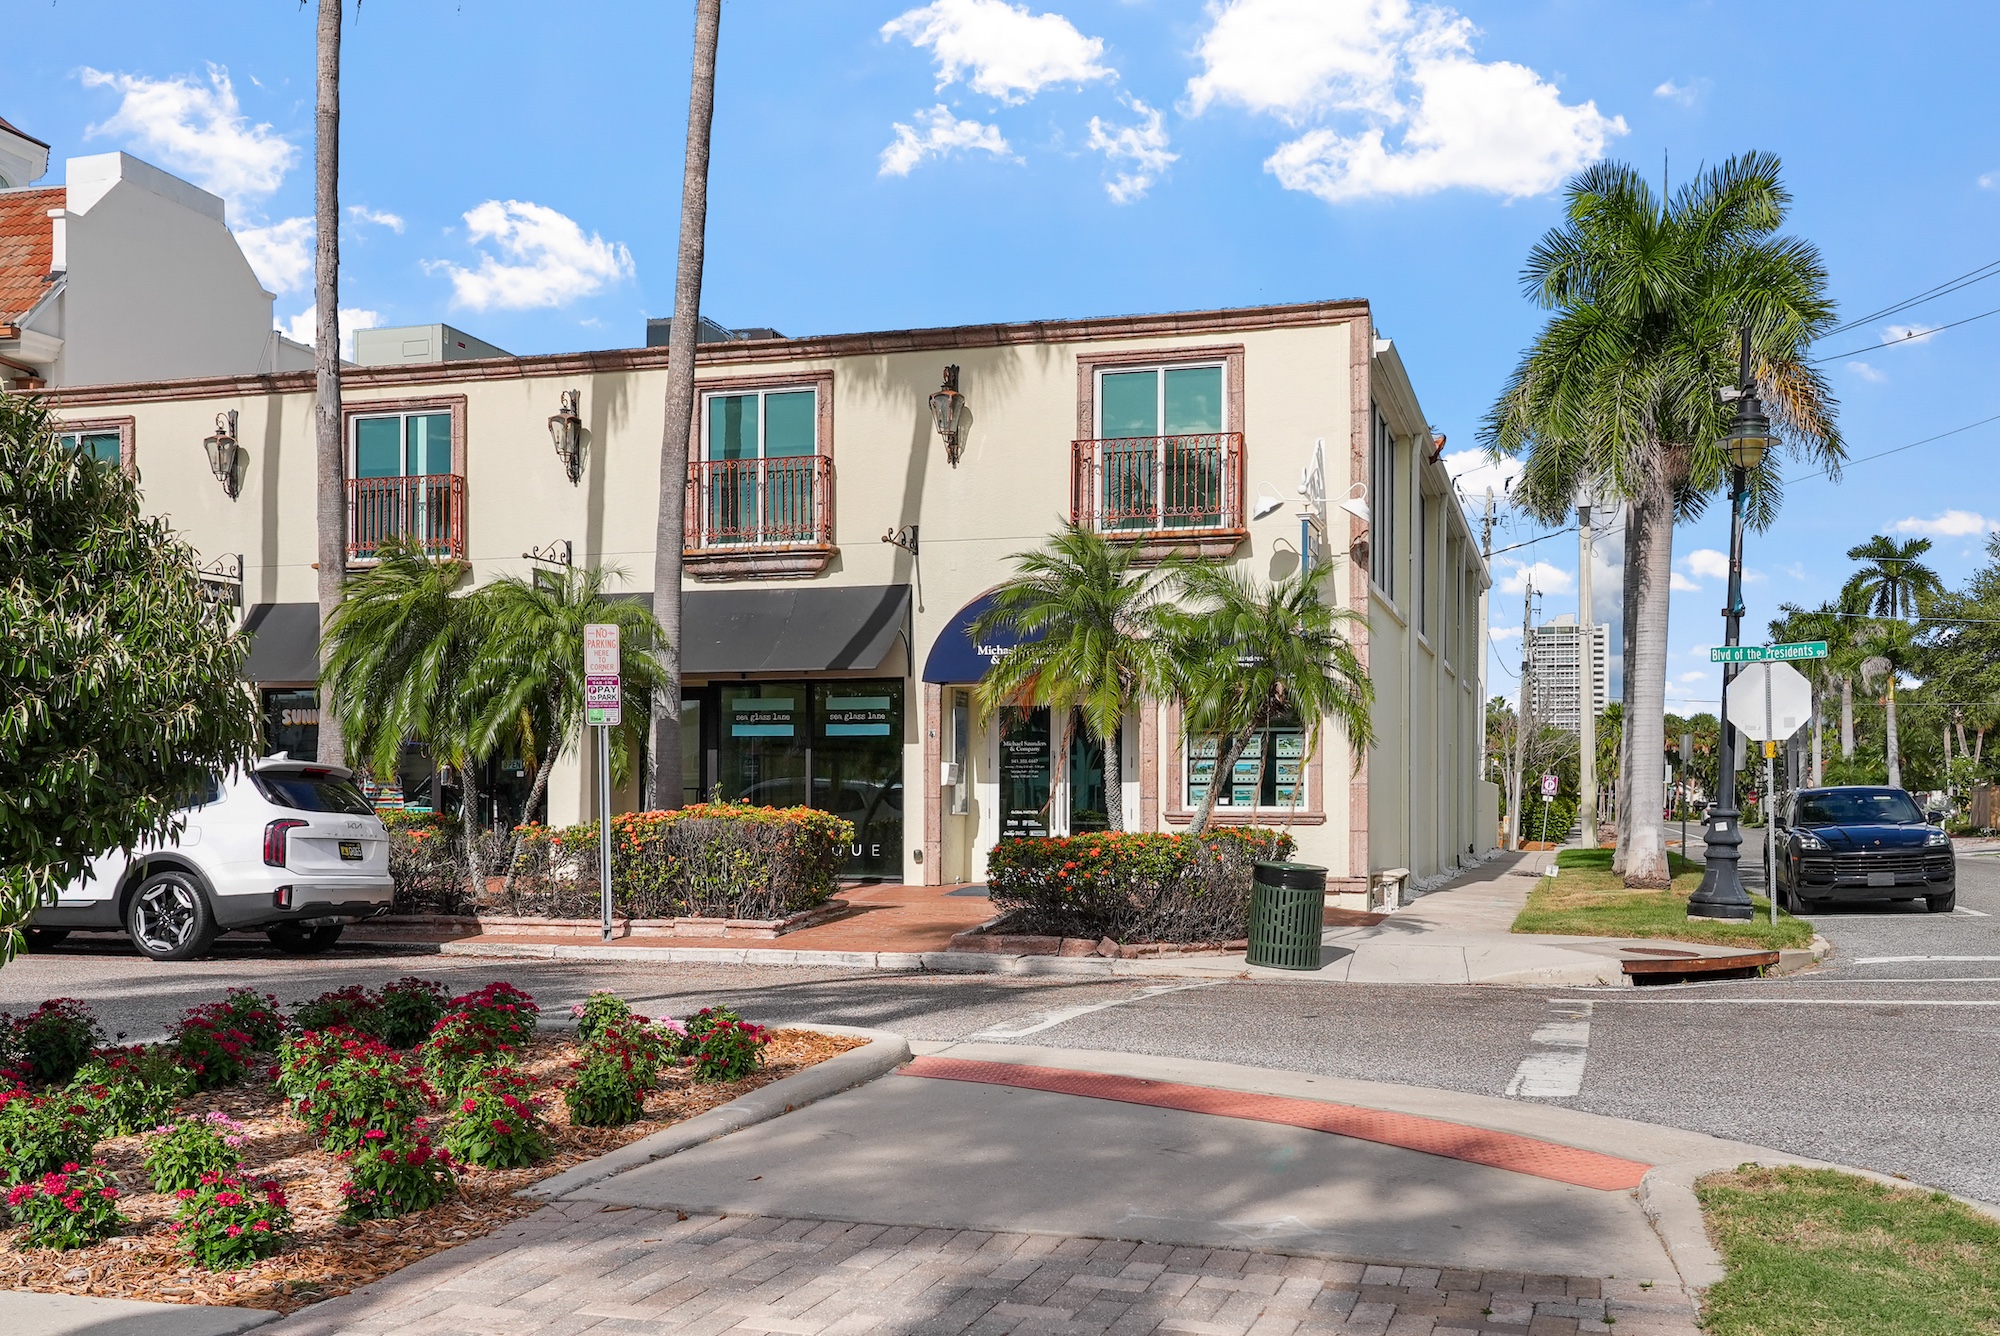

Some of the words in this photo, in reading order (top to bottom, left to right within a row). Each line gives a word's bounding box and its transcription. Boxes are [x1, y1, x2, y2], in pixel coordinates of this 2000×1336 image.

[595, 629, 607, 638] NO
[587, 639, 617, 649] PARKING
[1712, 649, 1731, 660] Blvd
[1734, 648, 1744, 660] of
[1746, 646, 1761, 660] the
[1766, 645, 1814, 660] Presidents
[990, 655, 1000, 665] &
[750, 713, 772, 722] glass
[772, 712, 791, 721] lane
[844, 712, 866, 721] glass
[868, 712, 886, 720] lane
[503, 760, 521, 769] OPEN
